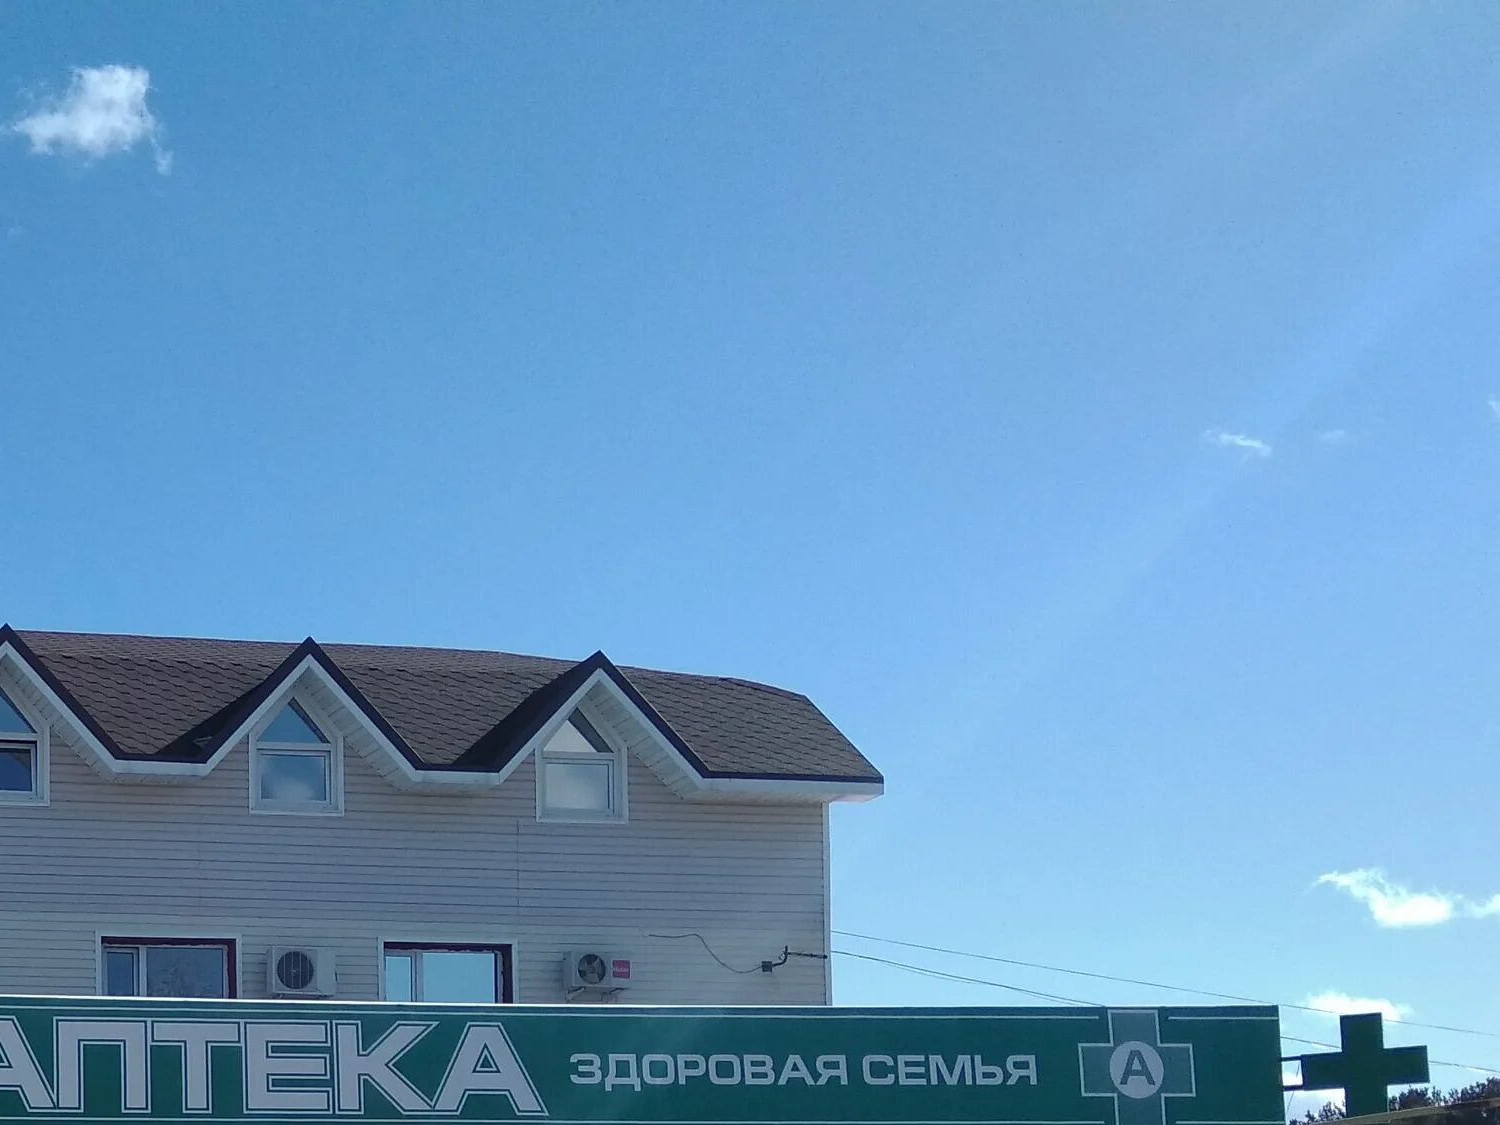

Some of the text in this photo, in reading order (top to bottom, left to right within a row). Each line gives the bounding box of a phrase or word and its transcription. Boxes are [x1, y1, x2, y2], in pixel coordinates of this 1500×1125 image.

[569, 1053, 1038, 1090] ЗДОРОВАЯ СЕМЬЯ
[1119, 1049, 1156, 1086] А
